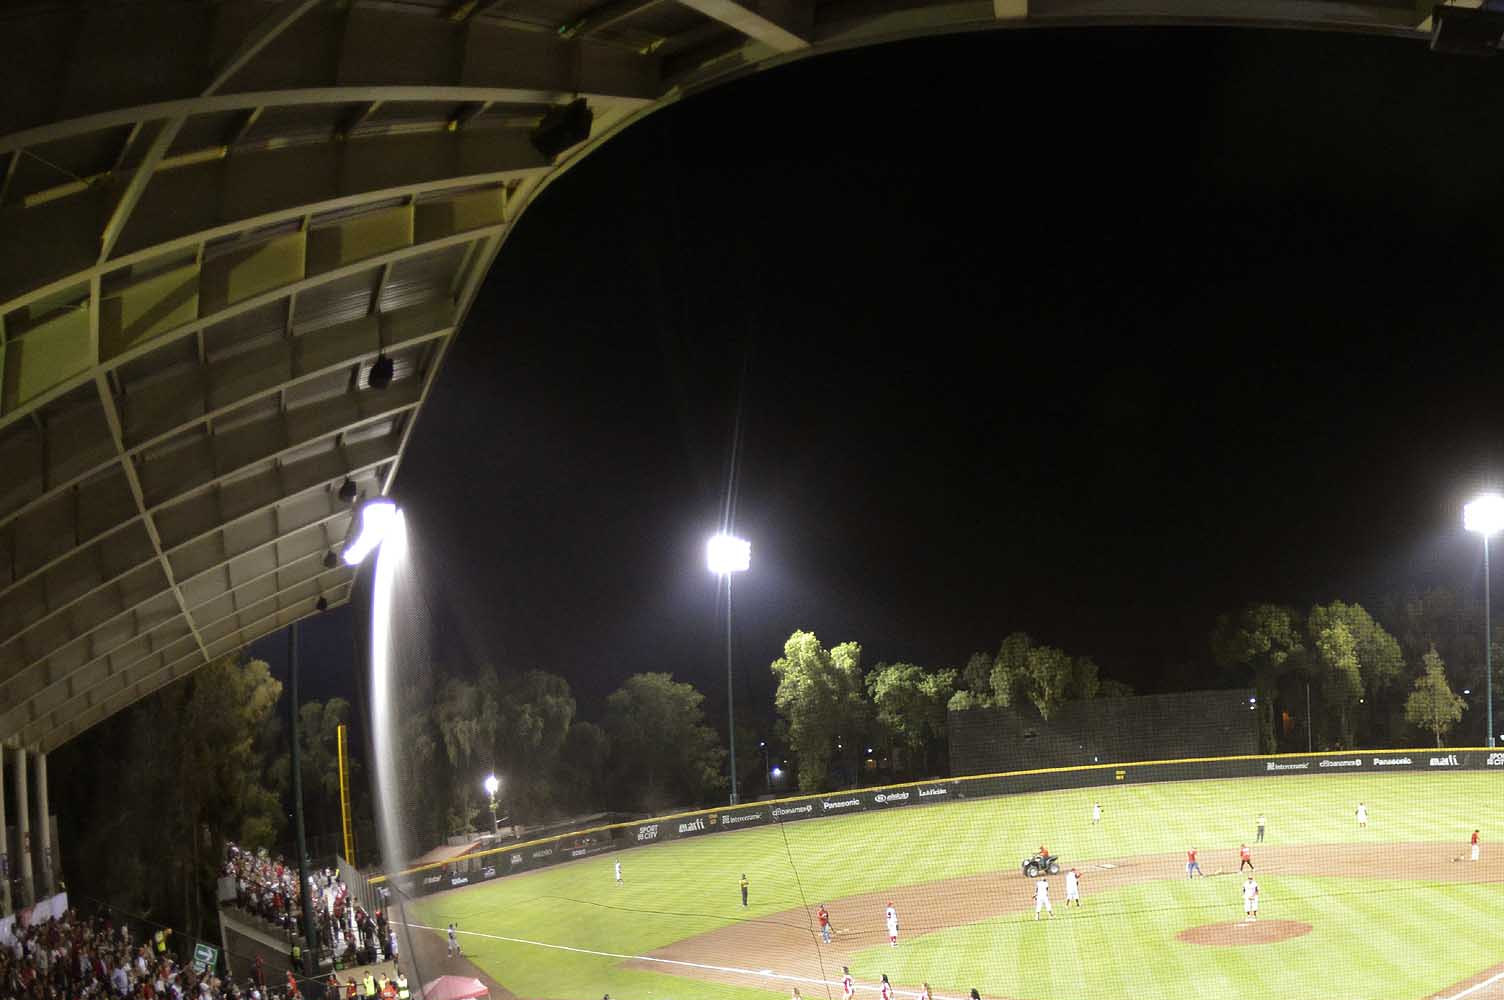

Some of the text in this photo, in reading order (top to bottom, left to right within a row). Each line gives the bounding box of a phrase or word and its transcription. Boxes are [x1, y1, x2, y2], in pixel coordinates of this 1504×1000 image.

[1373, 757, 1412, 766] Panasonic
[823, 798, 859, 809] Panasonic
[640, 824, 658, 834] SPORT
[644, 831, 658, 840] CITY
